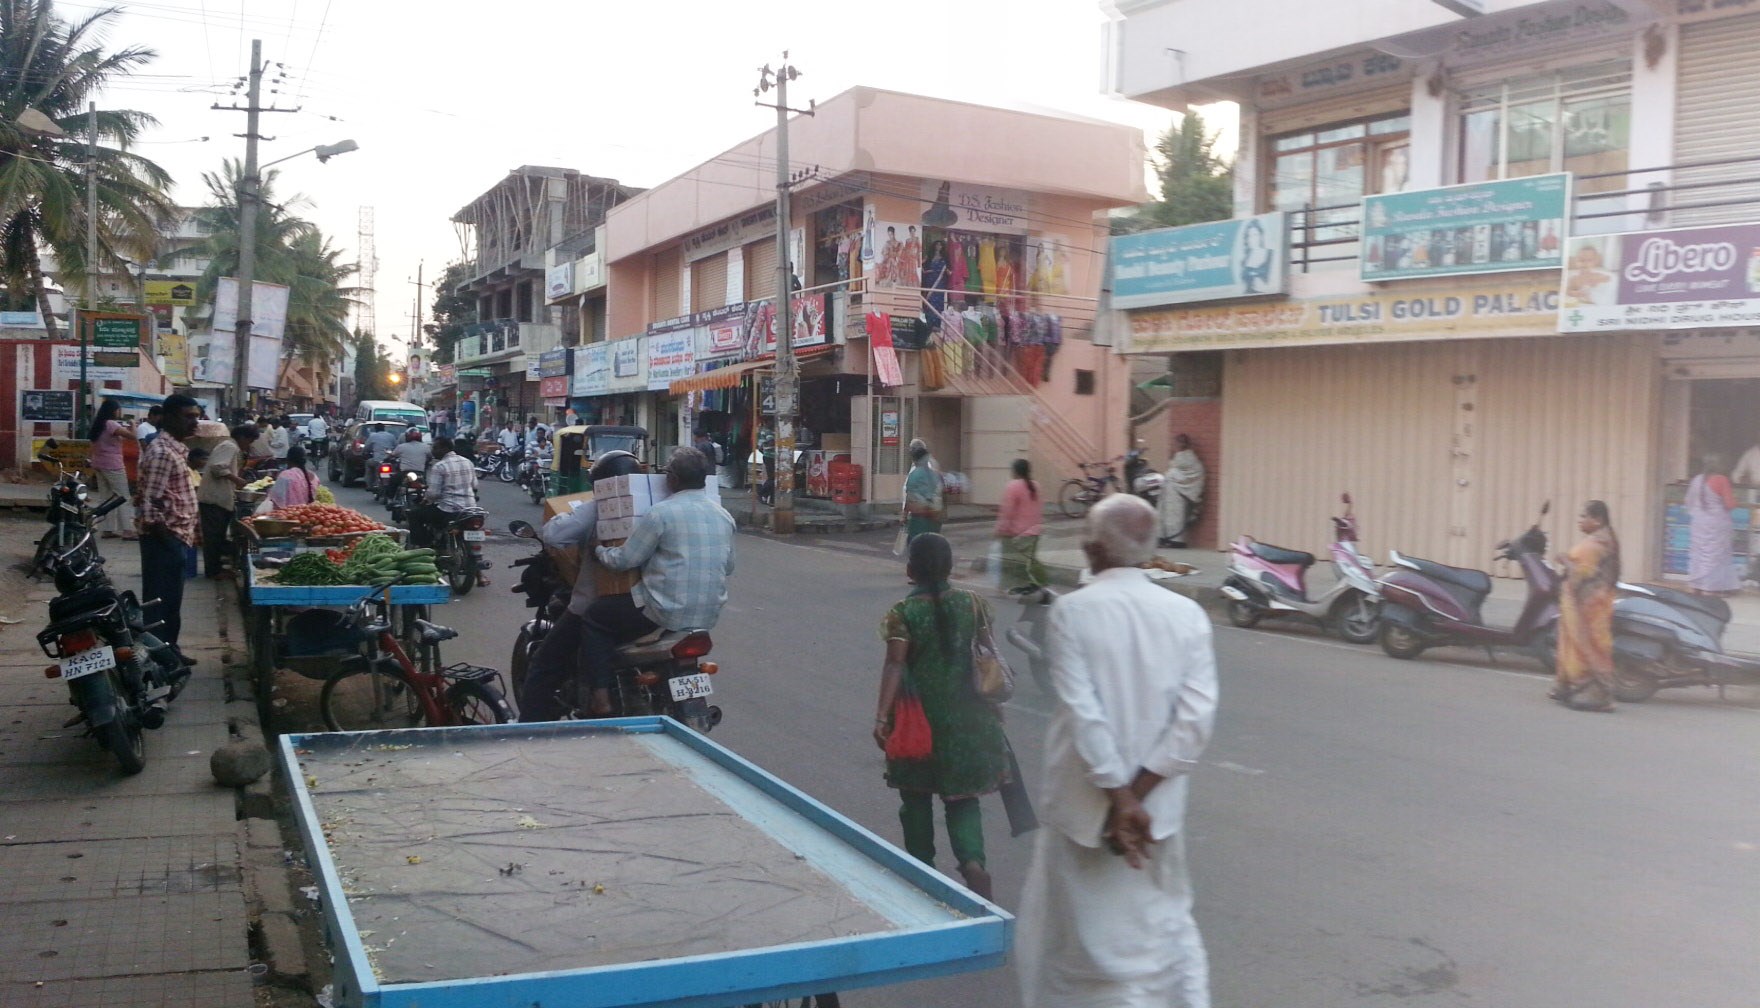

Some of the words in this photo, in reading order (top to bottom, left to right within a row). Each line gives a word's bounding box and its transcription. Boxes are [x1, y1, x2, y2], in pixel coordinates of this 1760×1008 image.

[967, 208, 1015, 226] Designer
[1625, 236, 1738, 284] Libero
[1318, 301, 1382, 325] TULSI
[1392, 298, 1462, 320] GOLD
[1596, 317, 1621, 327] SRI
[1671, 314, 1714, 323] DRUG
